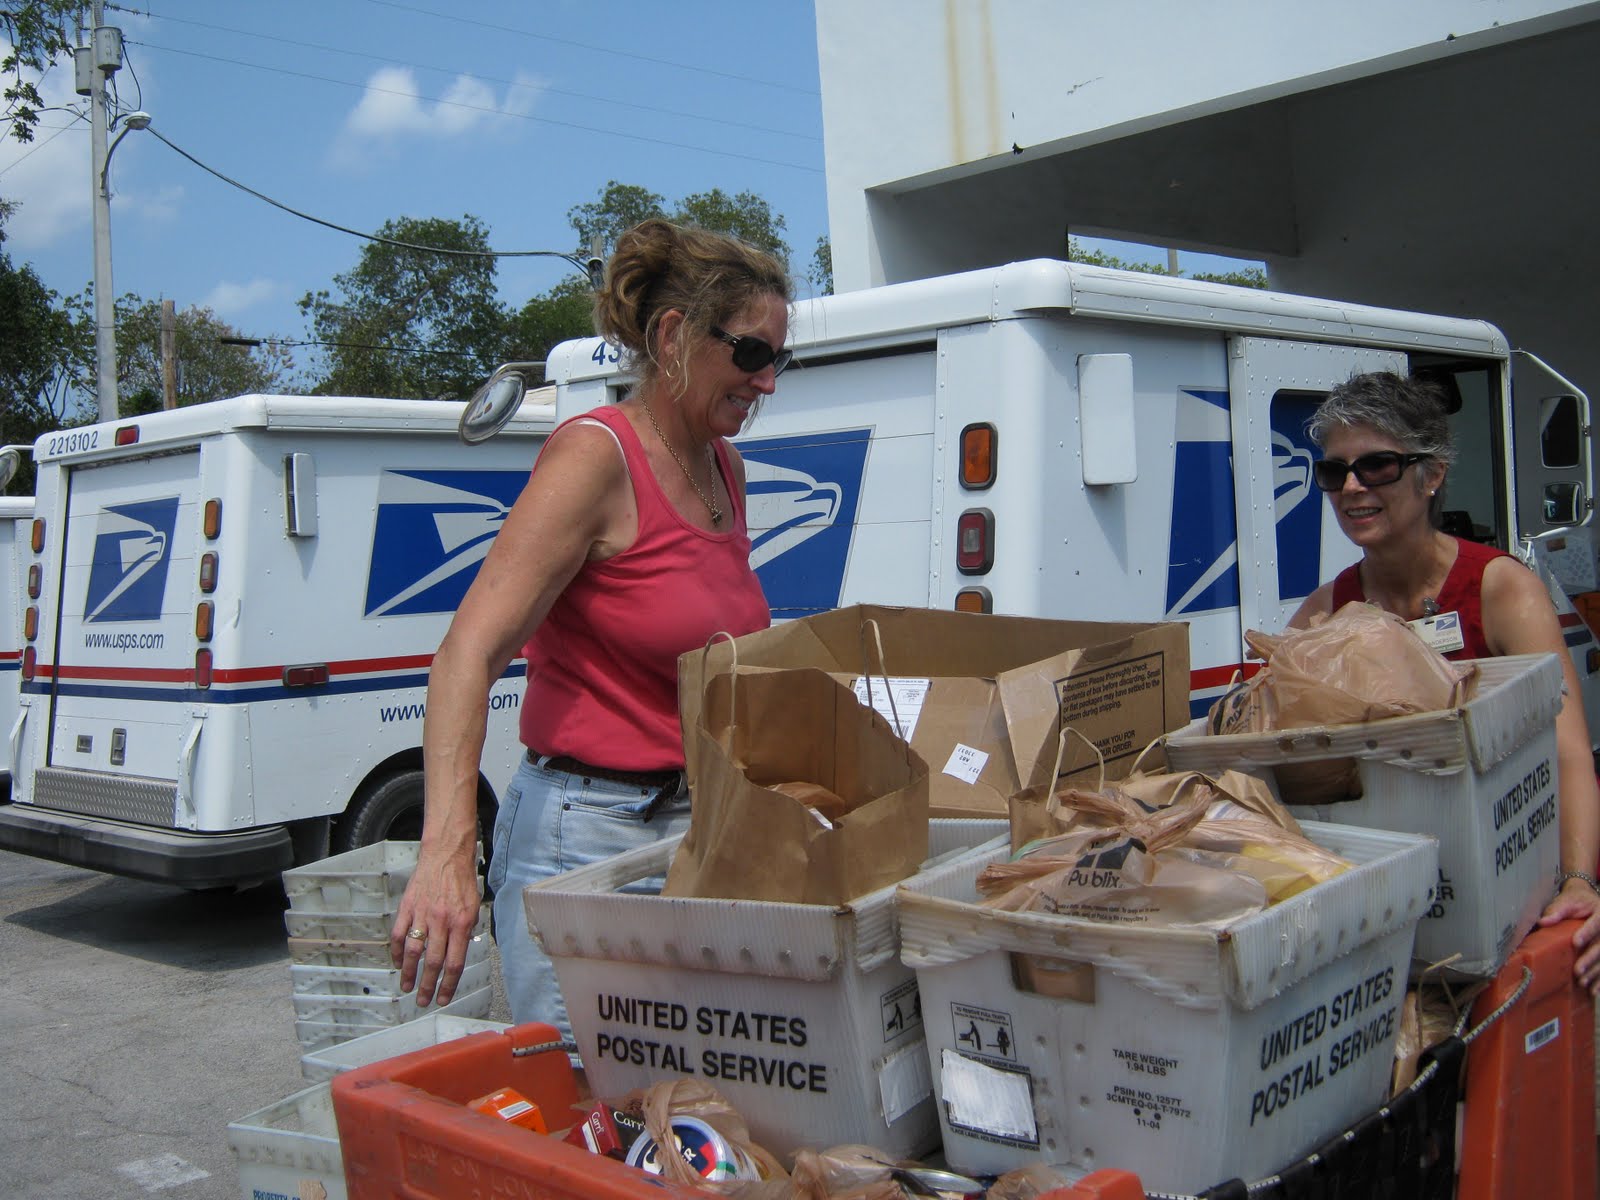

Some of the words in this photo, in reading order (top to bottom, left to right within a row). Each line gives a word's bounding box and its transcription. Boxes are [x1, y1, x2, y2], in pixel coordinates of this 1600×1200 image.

[48, 430, 99, 456] 2213102
[85, 633, 164, 653] www.usps.com
[1089, 675, 1105, 685] Please
[1105, 667, 1132, 680] thoroughly
[1132, 663, 1147, 672] check
[1064, 692, 1085, 703] contents
[1086, 689, 1092, 697] of
[1092, 686, 1102, 695] box
[1102, 681, 1118, 691] before
[1146, 669, 1160, 679] Small
[1078, 696, 1103, 710] packages
[1103, 692, 1115, 702] may
[1115, 688, 1128, 697] have
[1151, 678, 1160, 687] the
[1063, 712, 1082, 723] bottom
[1082, 706, 1098, 718] during
[1111, 733, 1123, 744] YOU
[1124, 730, 1135, 740] FOR
[1112, 741, 1132, 752] ORDER
[1493, 784, 1523, 831] UNITED
[1523, 758, 1551, 805] STATES
[1495, 830, 1528, 877] POSTAL
[1527, 793, 1556, 843] SERVICE
[1068, 869, 1120, 888] Publix
[597, 993, 688, 1031] UNITED
[696, 1006, 808, 1048] STATES
[1260, 1004, 1327, 1071] UNITED
[1330, 966, 1394, 1029] STATES
[597, 1032, 695, 1073] POSTAL
[701, 1049, 828, 1093] SERVICE
[1112, 1048, 1138, 1062] TARE
[1139, 1054, 1179, 1069] WEIGHT
[1126, 1061, 1145, 1072] 1.94
[1146, 1065, 1167, 1077] LBS
[1250, 1054, 1325, 1128] POSTAL
[1328, 1006, 1397, 1077] SERVICE
[1113, 1085, 1135, 1097] PSIN
[1138, 1090, 1154, 1102] NO.
[1156, 1095, 1182, 1107] 1257T
[591, 1111, 605, 1135] Carr's
[1136, 1117, 1160, 1129] 11-04
